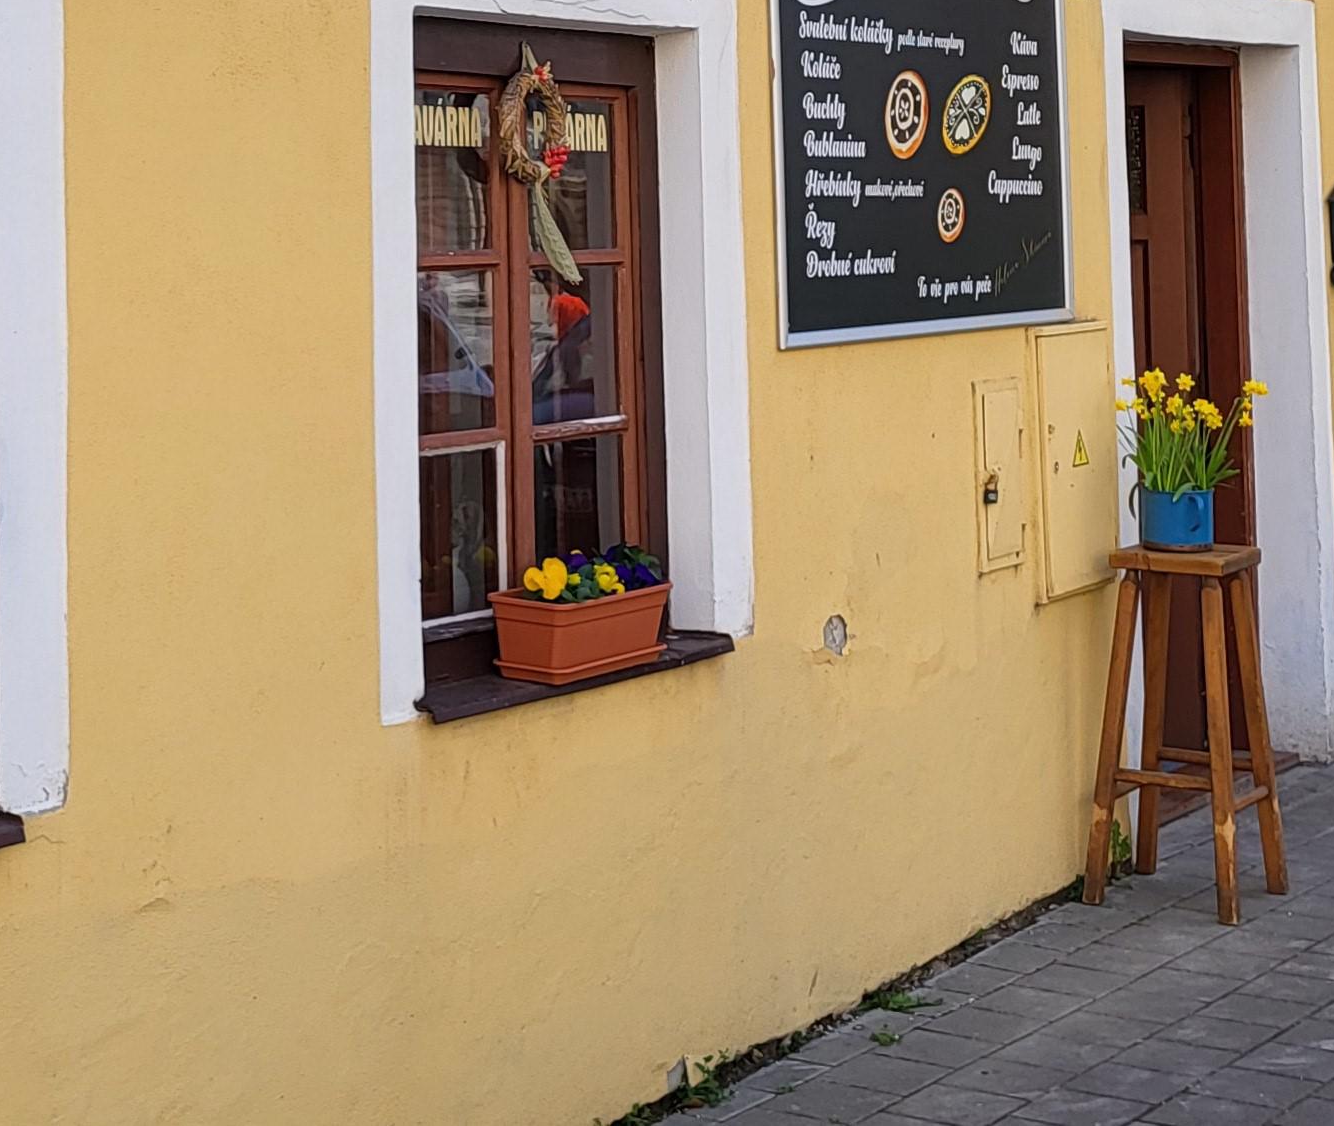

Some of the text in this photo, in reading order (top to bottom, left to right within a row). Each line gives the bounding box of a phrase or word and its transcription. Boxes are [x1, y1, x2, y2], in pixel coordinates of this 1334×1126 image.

[799, 10, 849, 42] Svatební
[851, 16, 893, 55] koláčky
[1010, 30, 1038, 56] Káva
[800, 50, 842, 80] Koláče
[1001, 64, 1040, 98] Espresso
[415, 98, 483, 148] AVÁRNA
[802, 91, 846, 130] Buchty
[1017, 101, 1042, 126] Latte
[533, 105, 608, 152] PÁRNA
[803, 129, 866, 159] Bublanina
[1011, 136, 1042, 171] Lungo
[805, 169, 861, 208] Hřebínky
[988, 170, 1043, 204] Cappuccino
[805, 204, 836, 249] Řezy
[806, 249, 897, 278] Drobné cukroví
[930, 278, 942, 297] vše
[944, 281, 958, 304] pro
[960, 276, 973, 296] vás
[975, 275, 992, 302] peče
